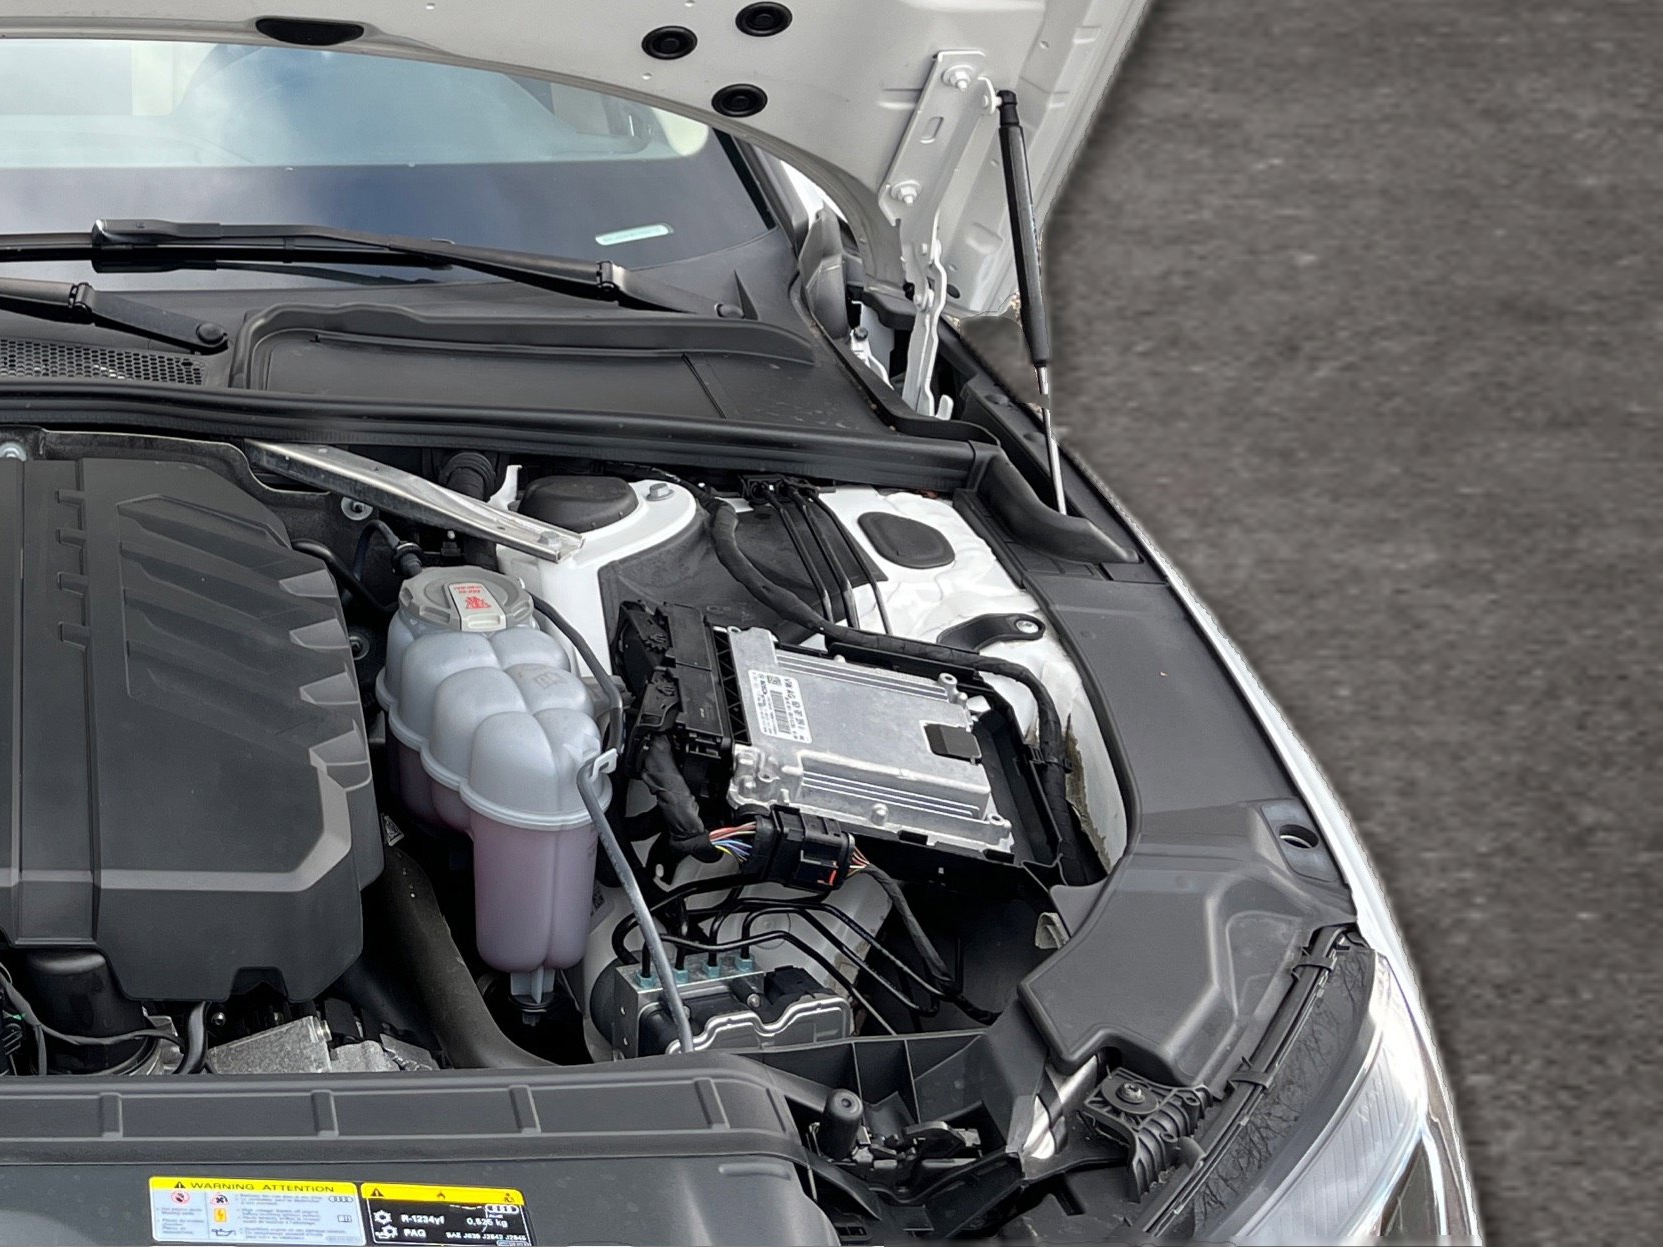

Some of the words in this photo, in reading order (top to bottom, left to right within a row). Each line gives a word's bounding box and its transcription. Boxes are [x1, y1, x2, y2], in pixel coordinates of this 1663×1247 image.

[190, 1181, 254, 1190] WARNING
[262, 1183, 335, 1193] ATTENTION
[496, 1218, 508, 1228] kg
[403, 1228, 427, 1238] PAG
